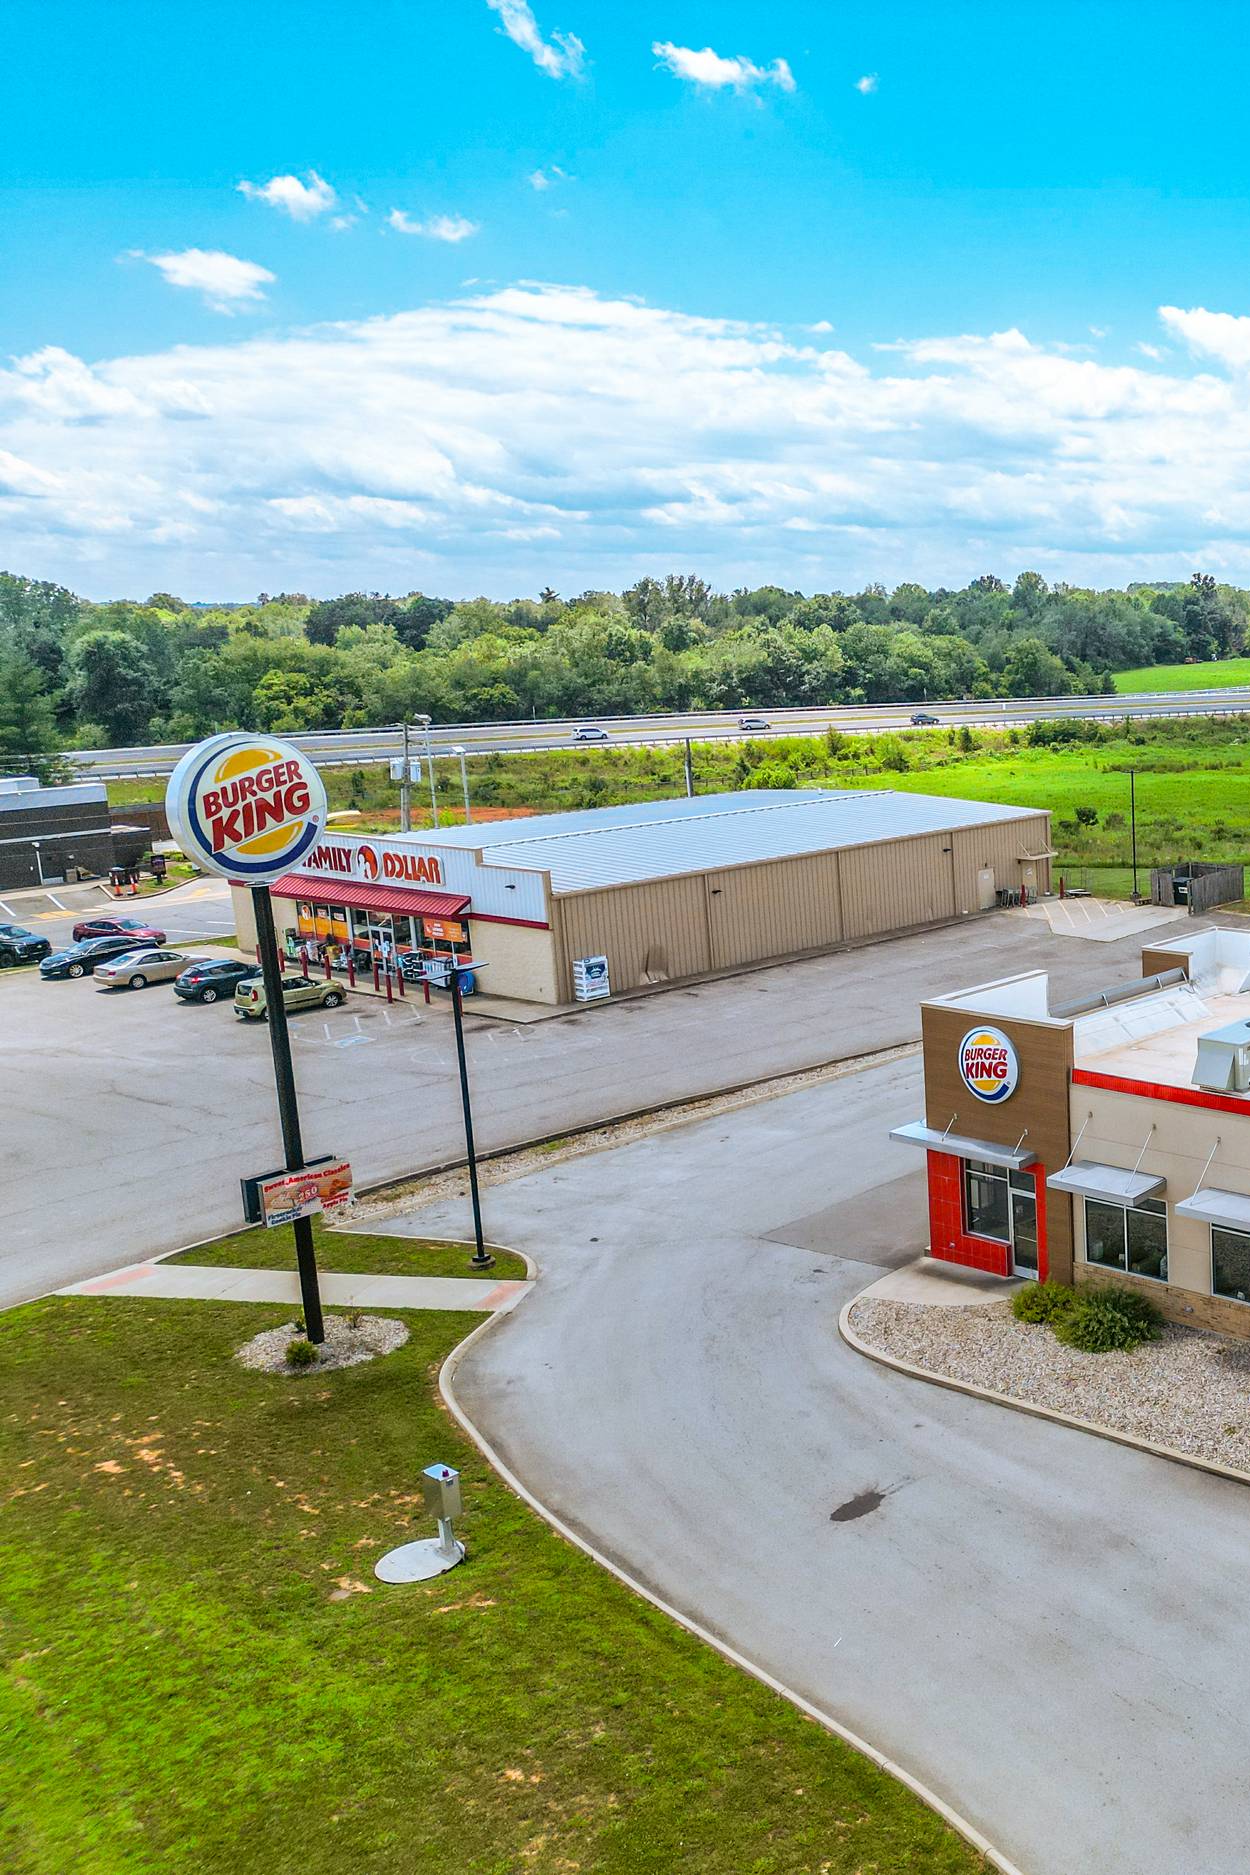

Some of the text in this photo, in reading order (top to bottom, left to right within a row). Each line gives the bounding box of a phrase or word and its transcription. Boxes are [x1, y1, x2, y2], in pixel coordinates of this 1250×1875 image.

[202, 760, 303, 820] BURGER
[212, 781, 310, 852] KING
[382, 852, 441, 884] DOLLAR
[964, 1047, 1008, 1061] BURGER
[965, 1061, 1008, 1079] KING
[285, 1173, 322, 1185] American
[323, 1163, 350, 1176] Classics
